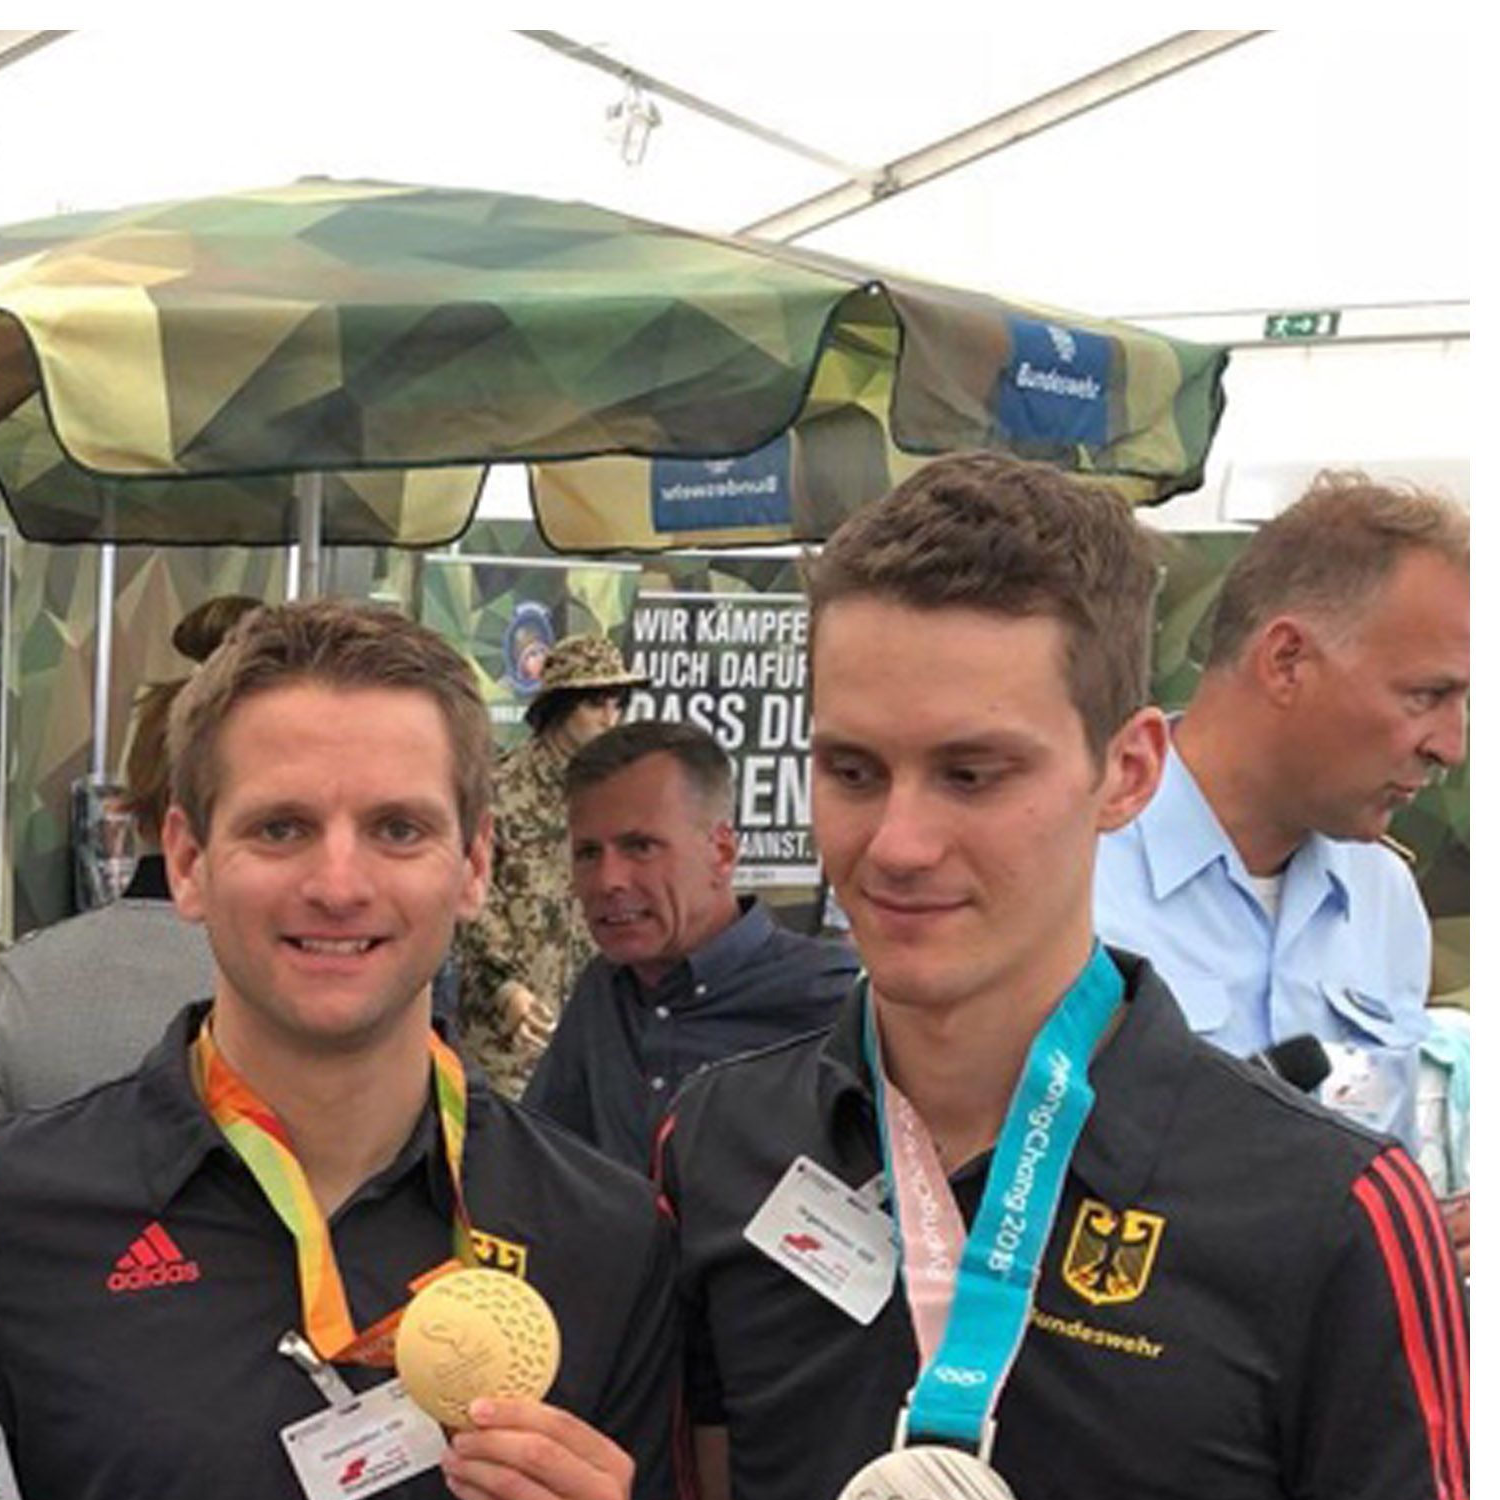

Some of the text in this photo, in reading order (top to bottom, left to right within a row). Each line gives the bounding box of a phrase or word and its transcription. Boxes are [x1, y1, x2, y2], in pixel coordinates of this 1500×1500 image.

[633, 606, 688, 643] WIR
[631, 650, 709, 688] AUCH
[730, 755, 813, 826] EN
[107, 1261, 199, 1291] adidas
[1030, 1306, 1165, 1359] undeswehr
